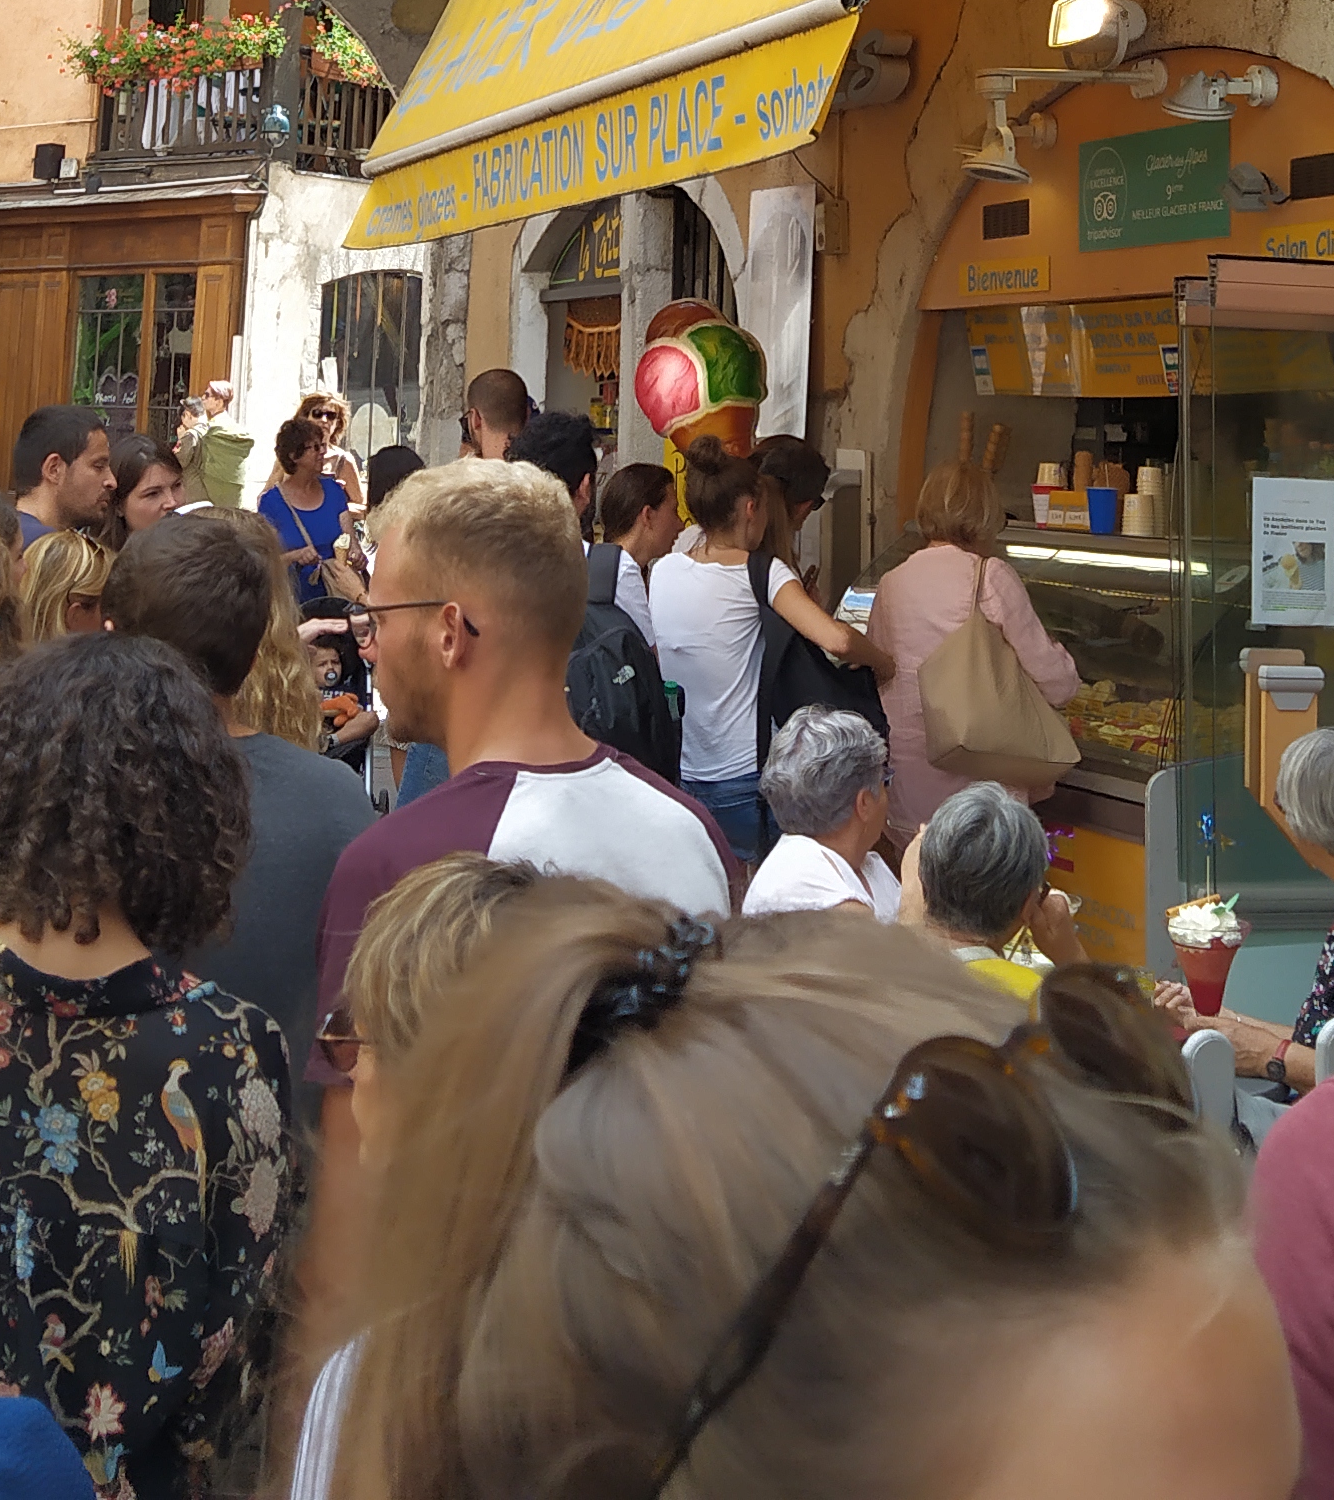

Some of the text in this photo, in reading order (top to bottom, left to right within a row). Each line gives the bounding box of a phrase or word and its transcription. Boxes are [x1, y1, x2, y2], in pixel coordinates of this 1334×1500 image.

[365, 201, 414, 239] crèmes
[471, 118, 584, 209] FABRICATION
[594, 109, 638, 184] SUR
[646, 74, 725, 176] PLACE
[1131, 199, 1225, 221] MEILLEUR GLACIER DE FRANCE
[1266, 236, 1308, 259] Salon
[967, 264, 1039, 293] Bienvenue
